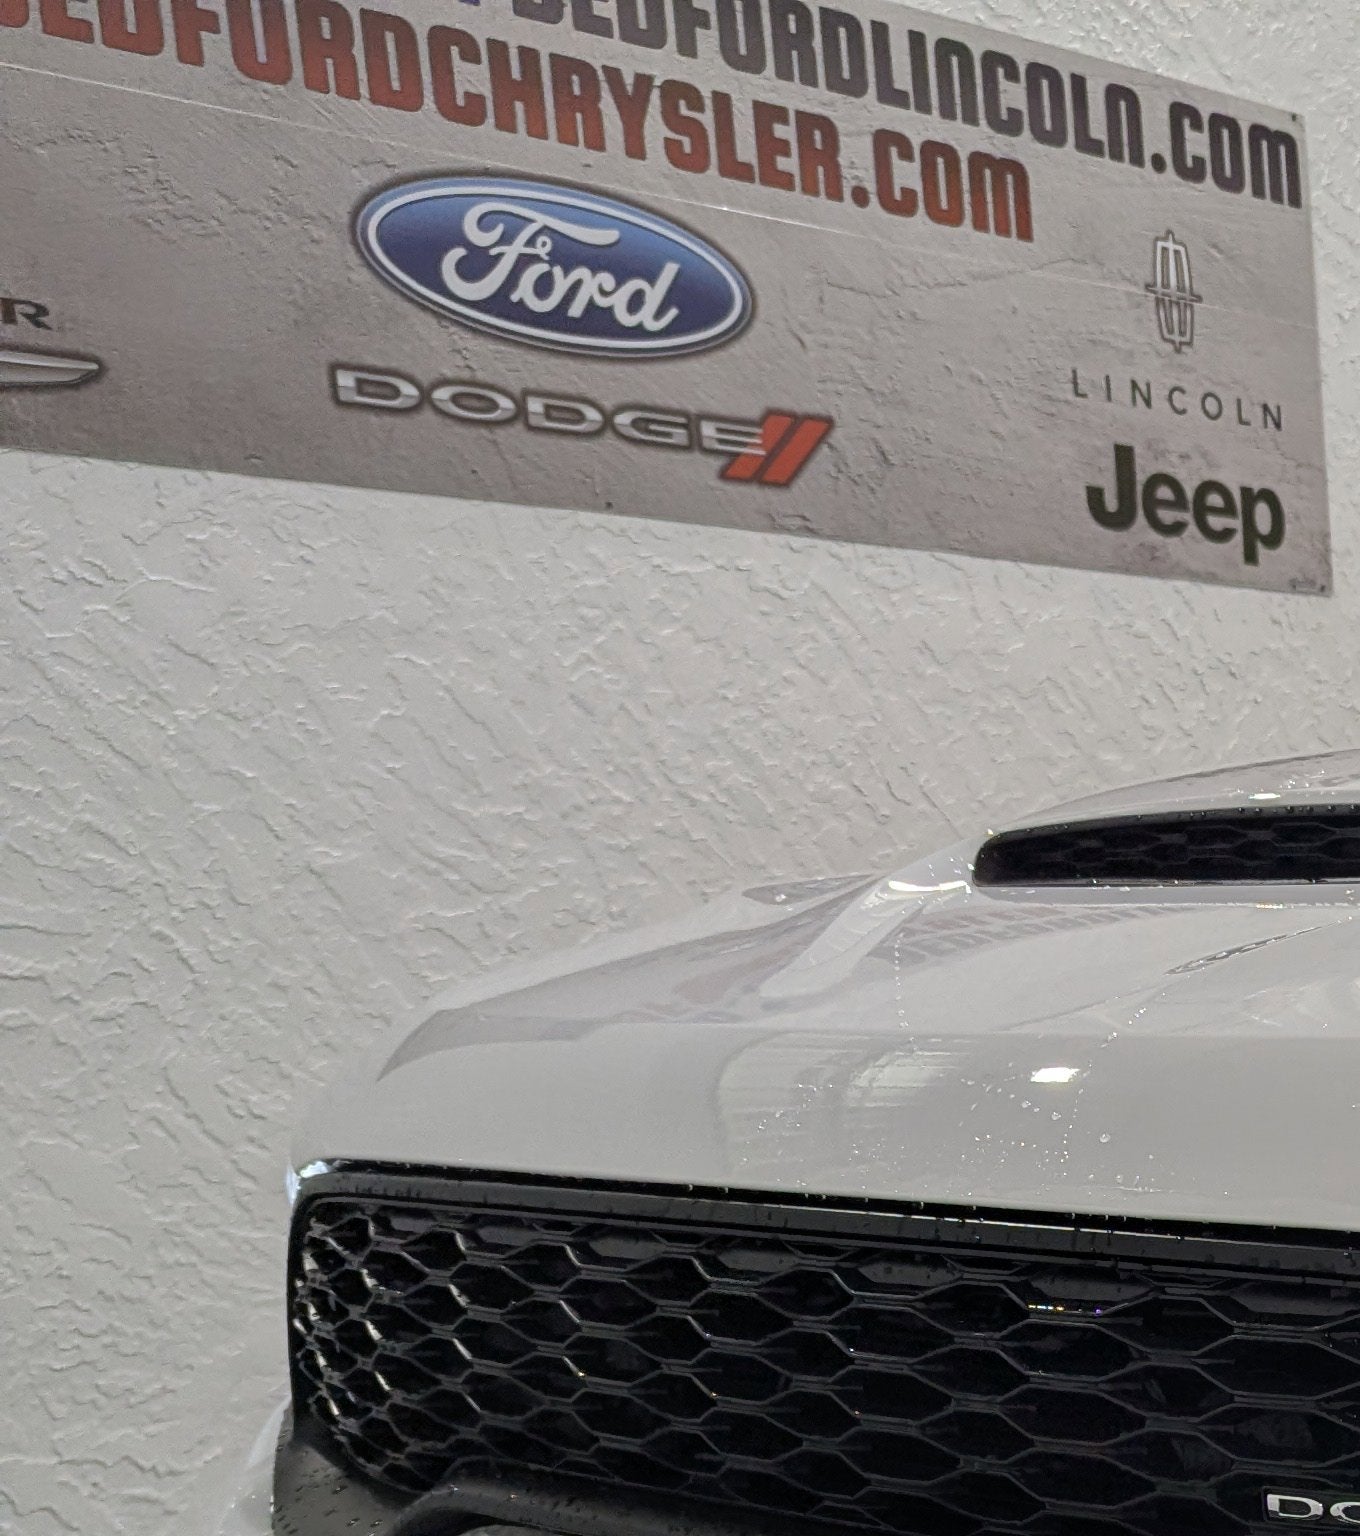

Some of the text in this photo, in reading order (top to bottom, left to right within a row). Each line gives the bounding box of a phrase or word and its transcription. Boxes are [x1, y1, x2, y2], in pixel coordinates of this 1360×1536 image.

[0, 0, 1033, 241] DFORDCHRYSLER.COM
[512, 0, 1301, 208] DFORDLINCOLN.COM
[441, 201, 680, 332] Ford
[334, 368, 767, 456] DODGE
[1072, 368, 1282, 432] LINCOLN
[1085, 443, 1285, 565] Jeep
